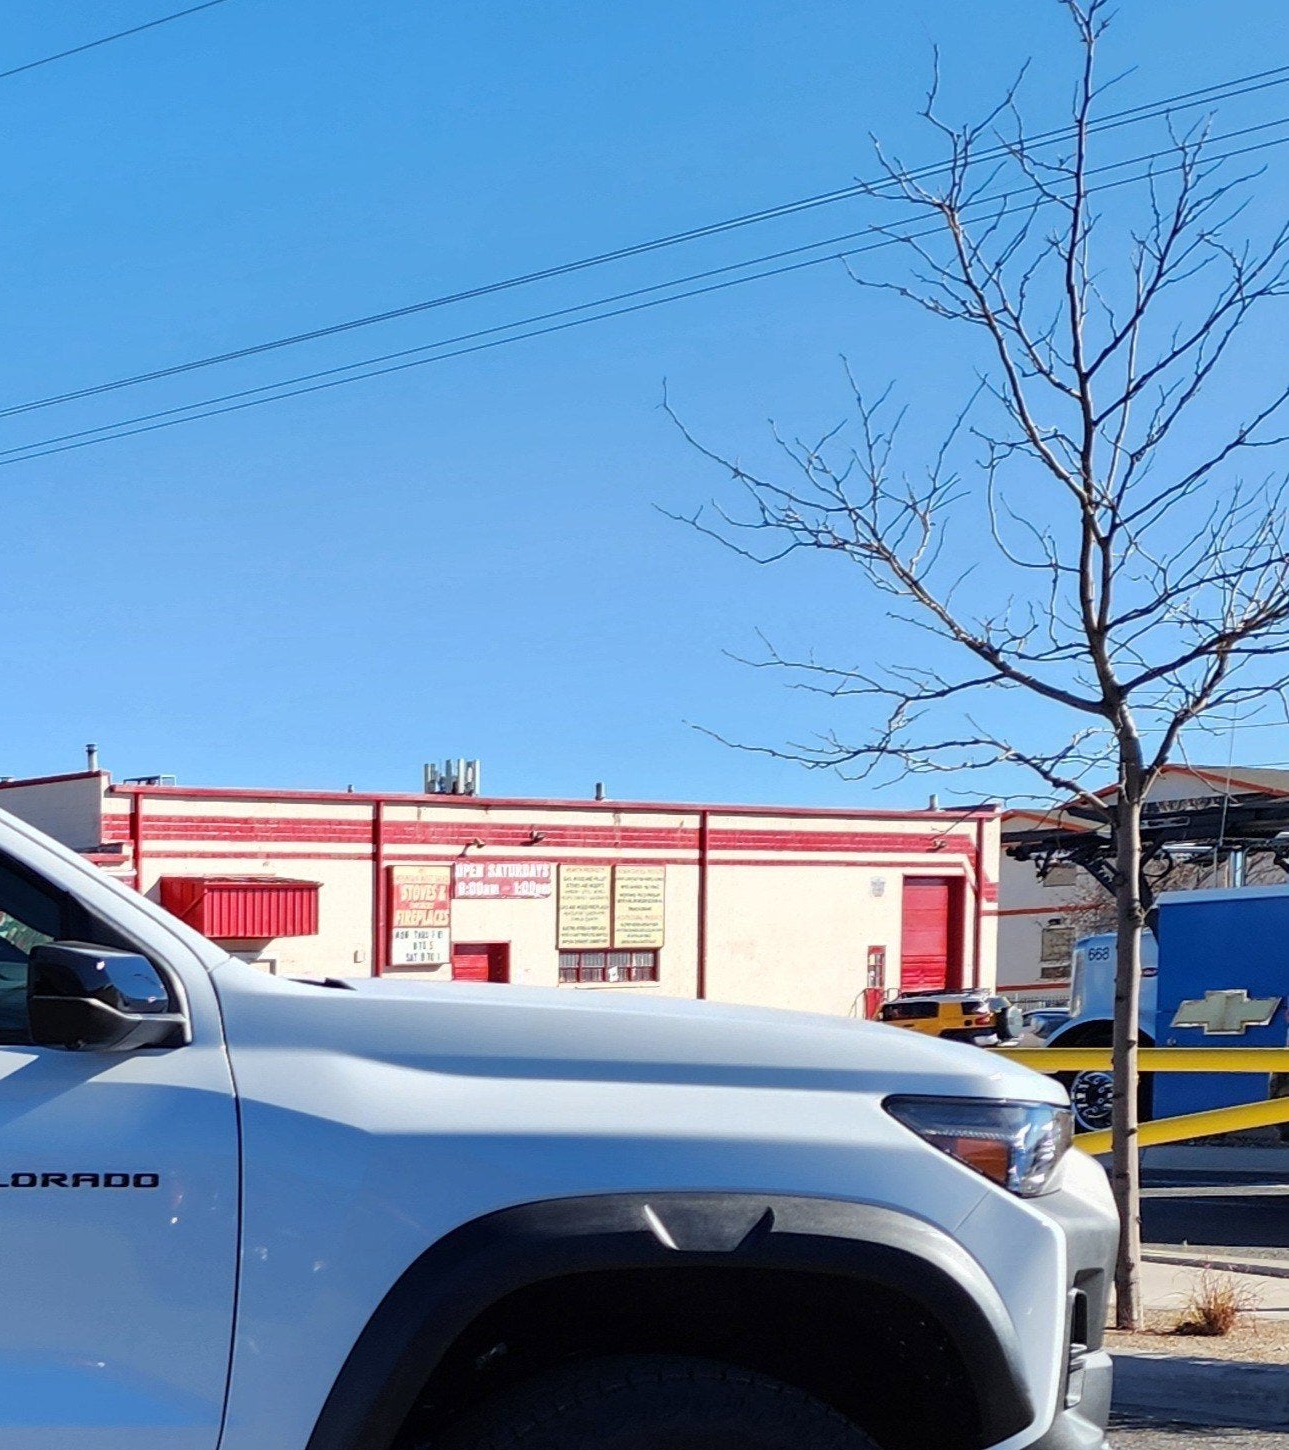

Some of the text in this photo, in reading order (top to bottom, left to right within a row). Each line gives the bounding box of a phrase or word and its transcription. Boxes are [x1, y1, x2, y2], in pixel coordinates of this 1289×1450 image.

[455, 863, 551, 878] OPEN SATURDAYS
[399, 884, 436, 902] STOVES
[396, 909, 450, 926] FIREPLACES
